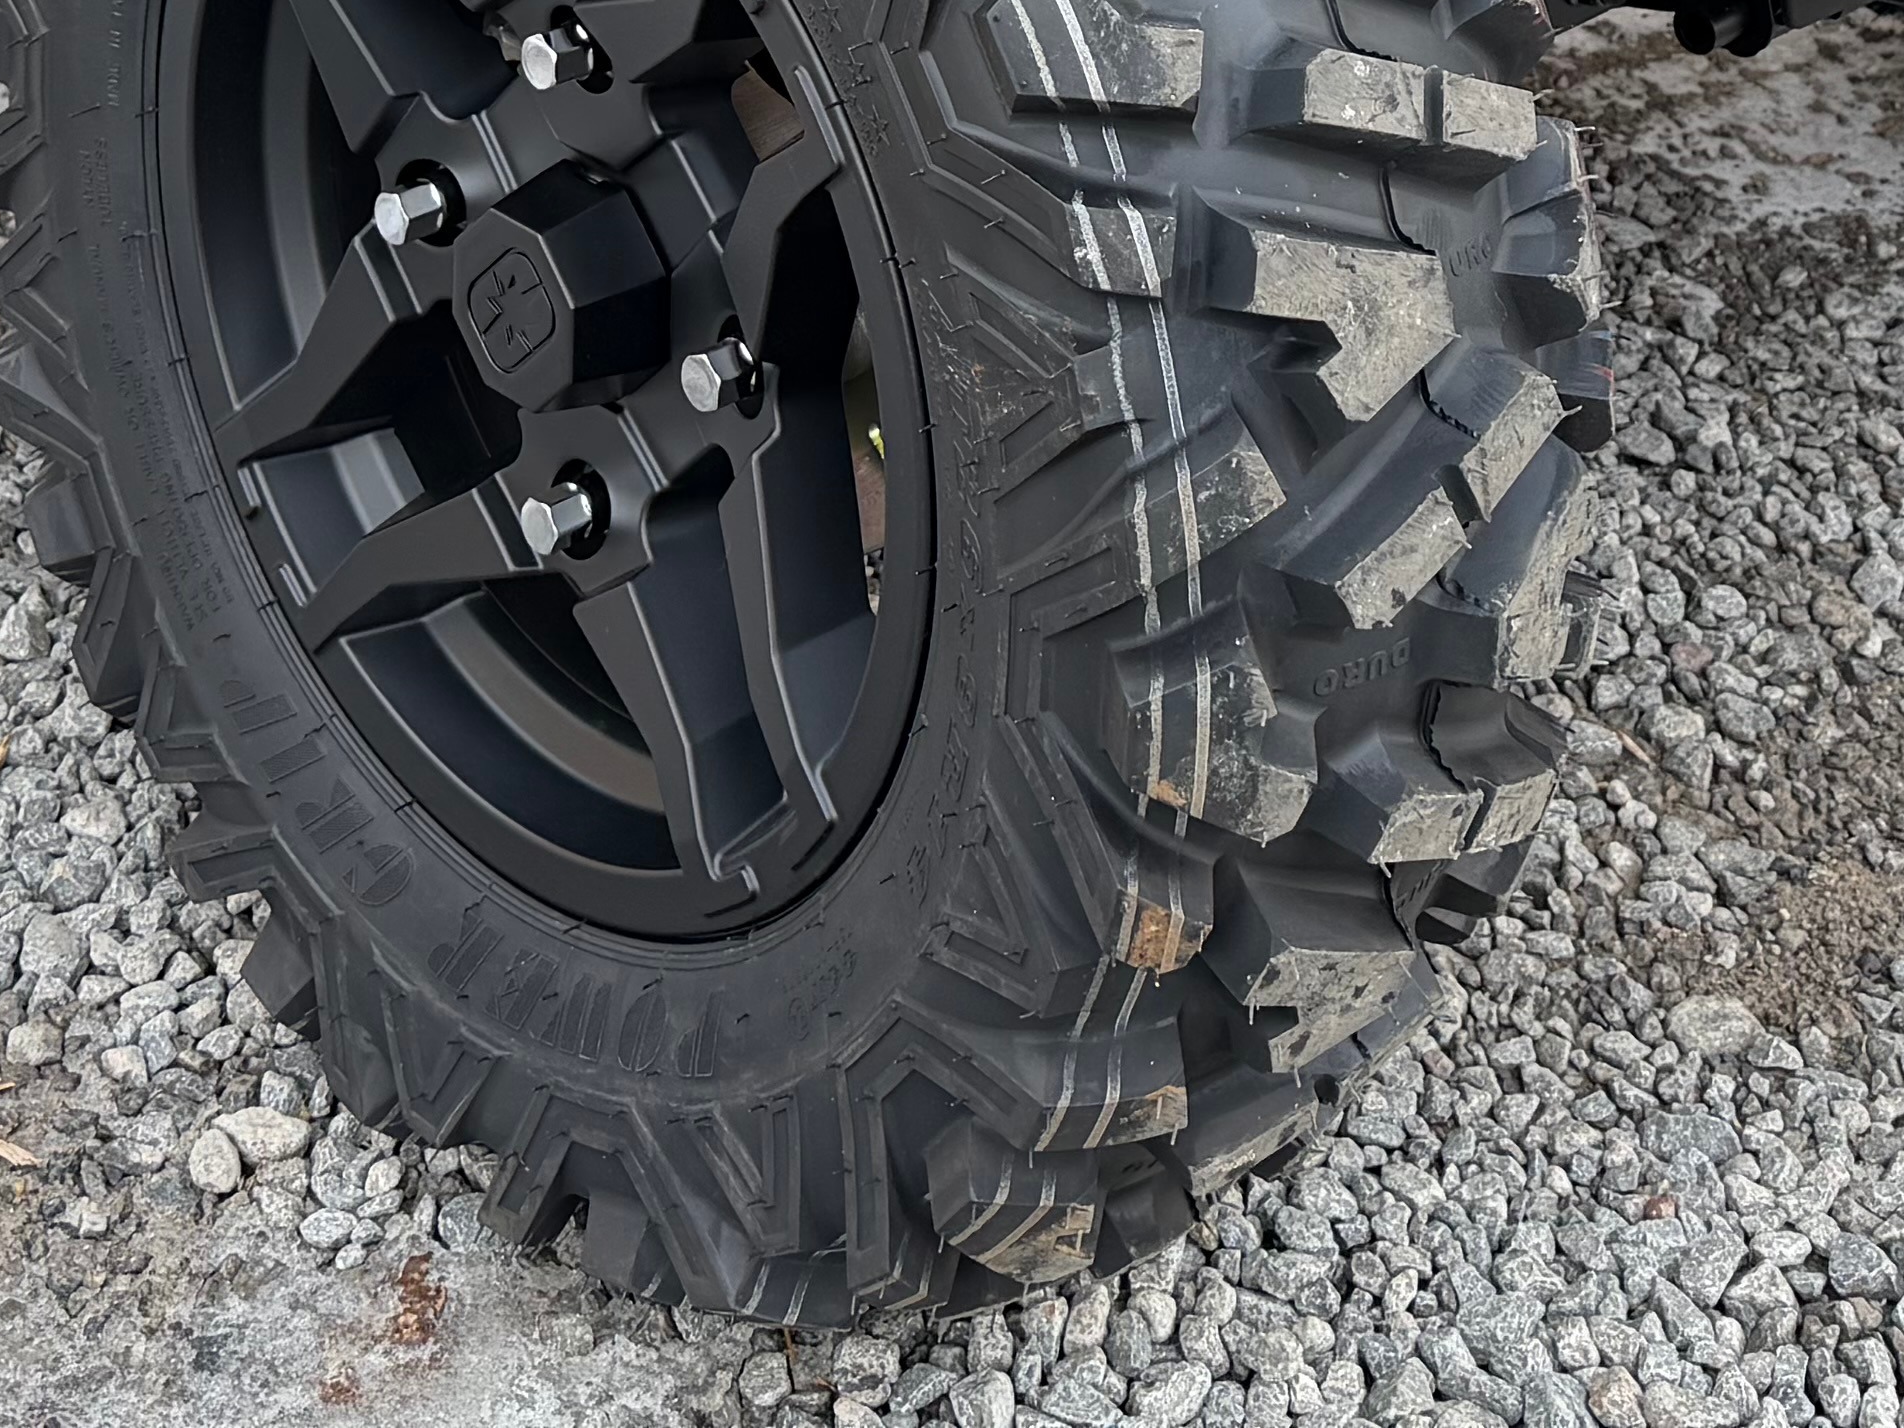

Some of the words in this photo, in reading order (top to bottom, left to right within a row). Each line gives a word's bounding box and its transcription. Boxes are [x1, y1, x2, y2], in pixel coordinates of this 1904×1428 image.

[1312, 635, 1412, 701] DURO
[217, 679, 414, 909] GRIP
[427, 917, 724, 1079] POWER
